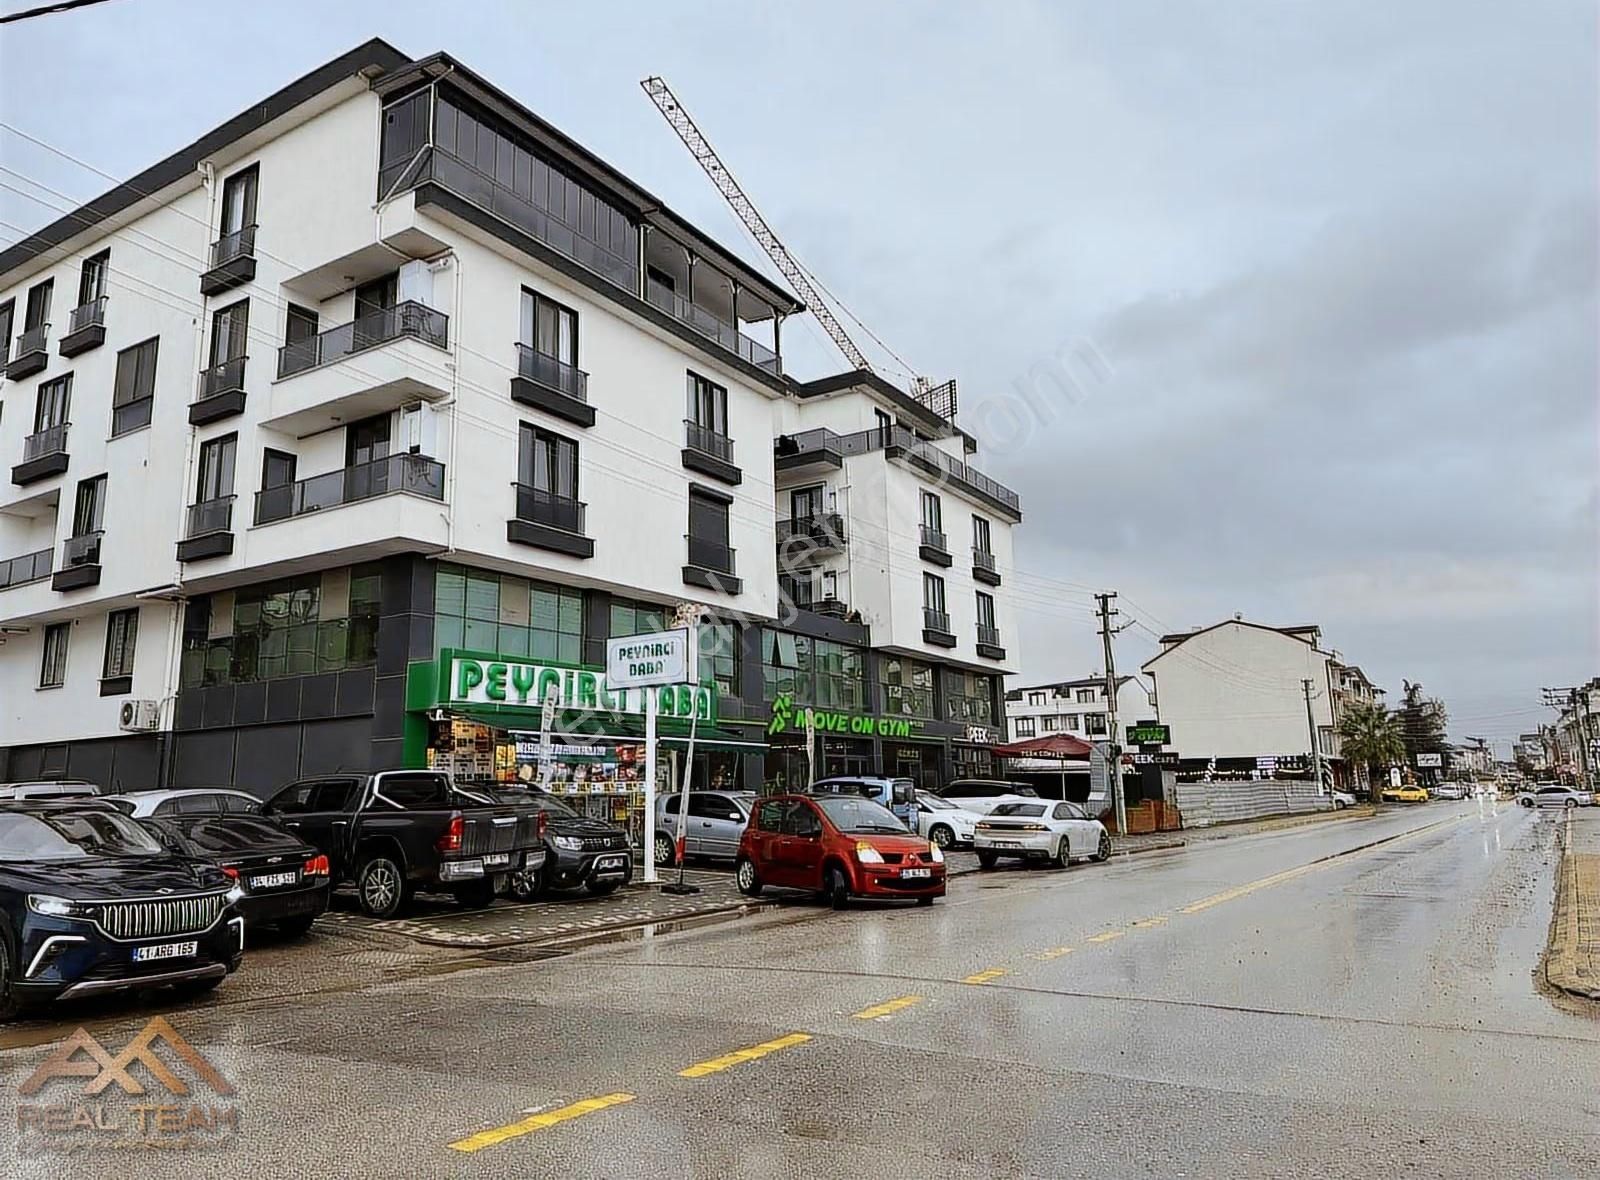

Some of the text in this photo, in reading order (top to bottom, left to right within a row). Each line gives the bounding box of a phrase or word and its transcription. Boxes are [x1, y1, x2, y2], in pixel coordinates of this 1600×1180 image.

[795, 709, 848, 732] MOVE
[851, 716, 874, 734] ON
[878, 718, 911, 737] GYM
